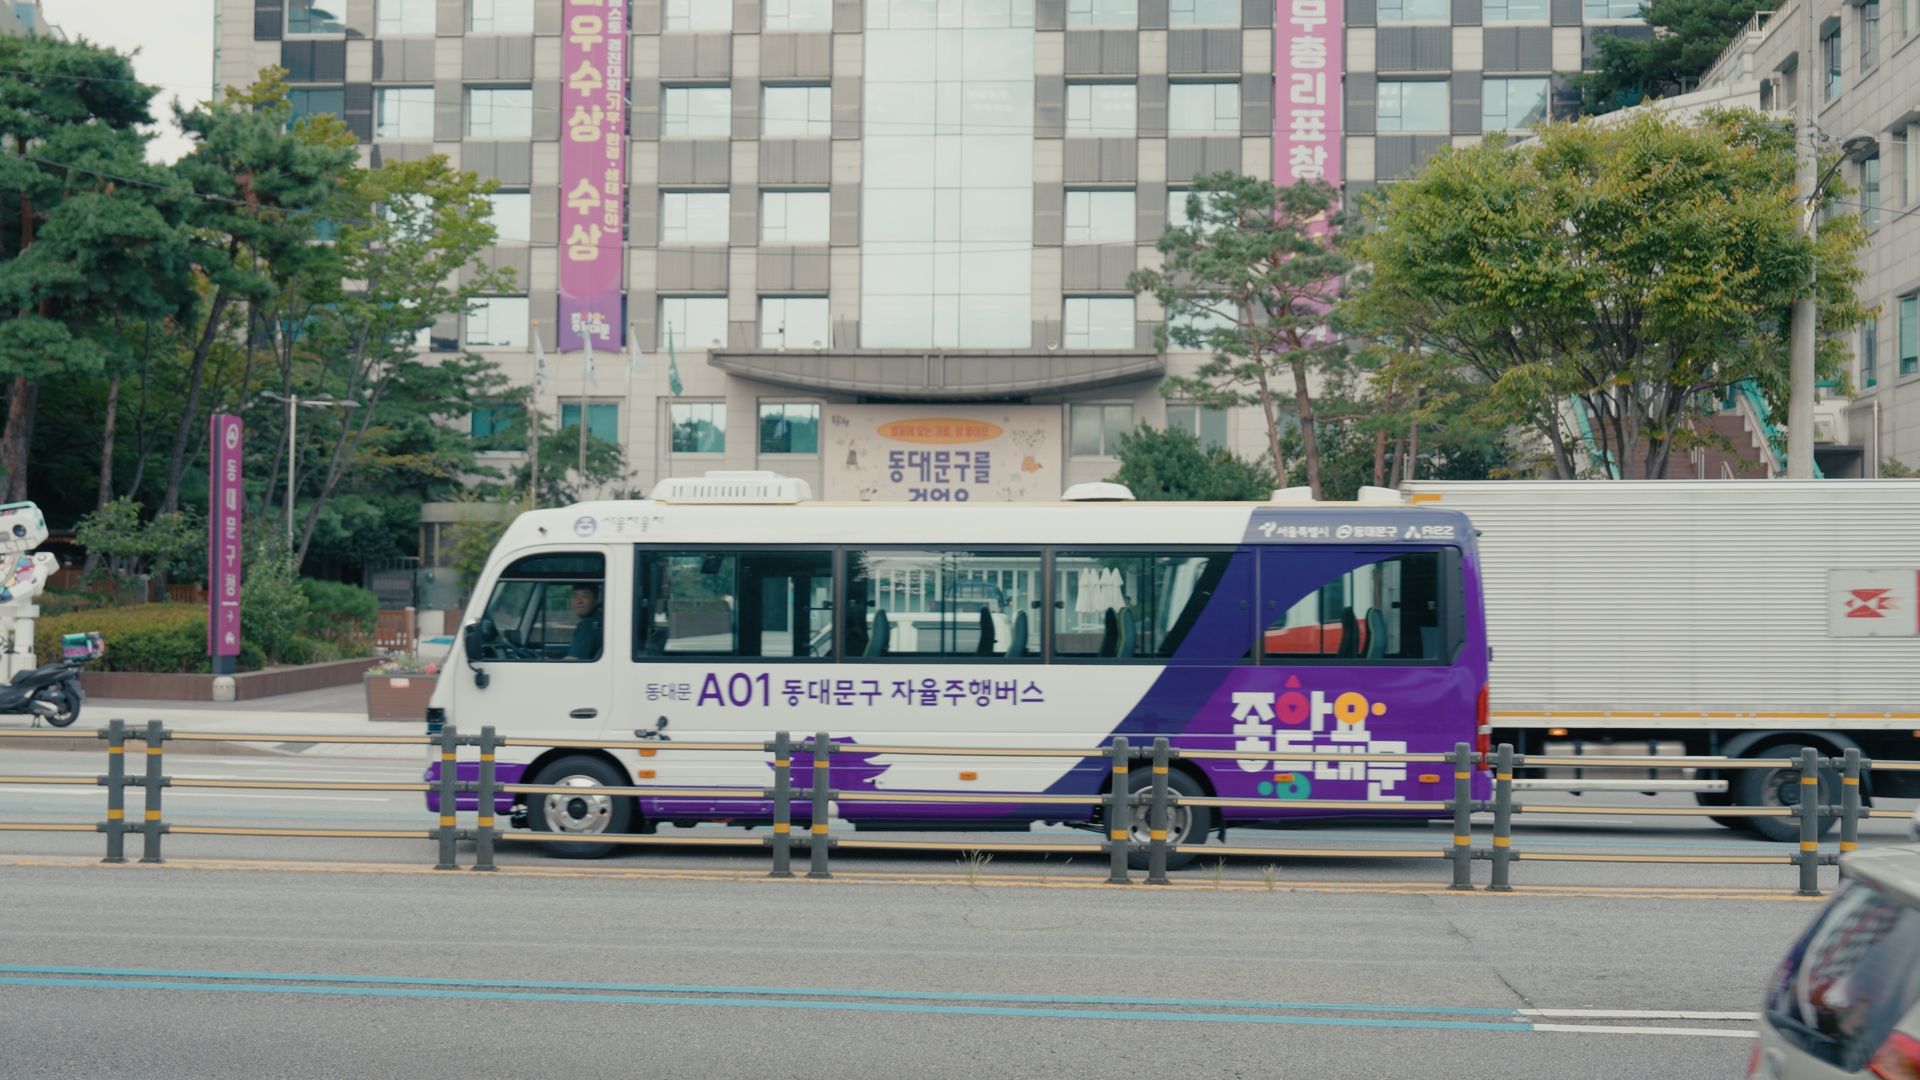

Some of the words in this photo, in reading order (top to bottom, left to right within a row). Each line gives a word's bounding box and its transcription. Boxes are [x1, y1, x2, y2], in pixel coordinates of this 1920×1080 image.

[569, 0, 604, 142] 우수상
[567, 178, 602, 261] 수상
[888, 450, 991, 484] 동대문구를
[1353, 525, 1397, 539] 동대문구
[645, 682, 692, 702] 동대문
[696, 671, 770, 708] A01
[781, 678, 883, 707] 동대문구
[891, 677, 1045, 708] 자율주행버스
